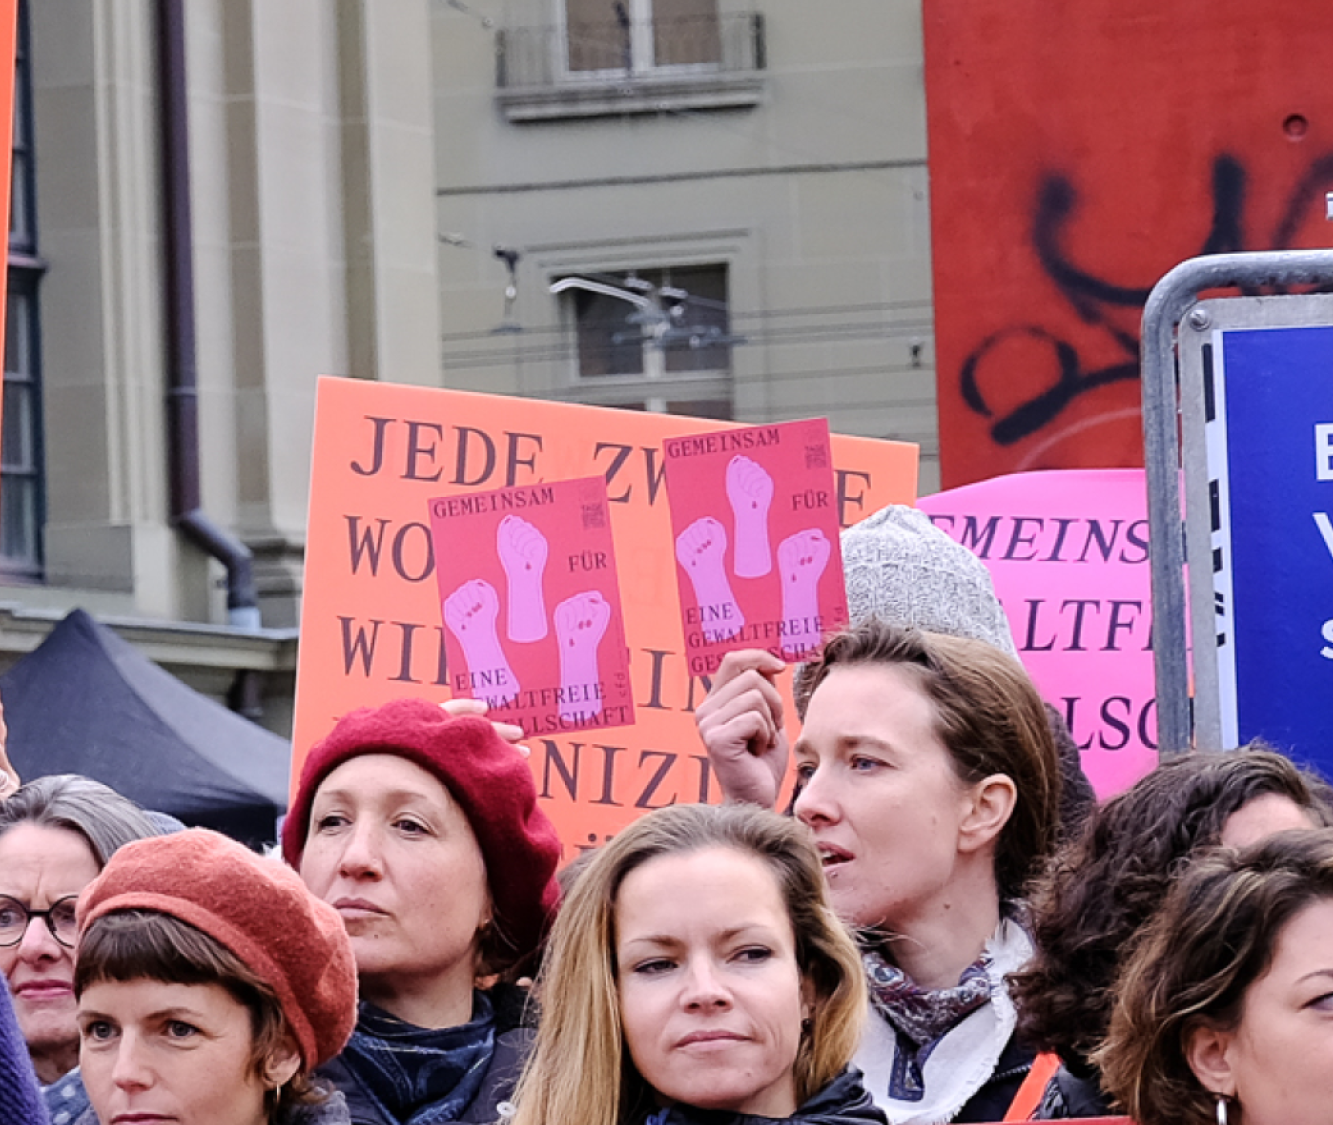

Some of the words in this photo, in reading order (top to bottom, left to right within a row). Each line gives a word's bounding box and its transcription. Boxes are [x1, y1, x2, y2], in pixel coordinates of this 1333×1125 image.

[350, 414, 544, 488] JEDE
[668, 429, 781, 458] GEMEINSAM
[434, 488, 555, 519] GEMEINSAM
[792, 489, 829, 511] FÜR
[568, 551, 608, 572] FÜR
[687, 602, 733, 625] EINE
[688, 615, 825, 648] GEWALTFREIE
[455, 668, 508, 691] EINE
[477, 682, 607, 712] WALTFREIE
